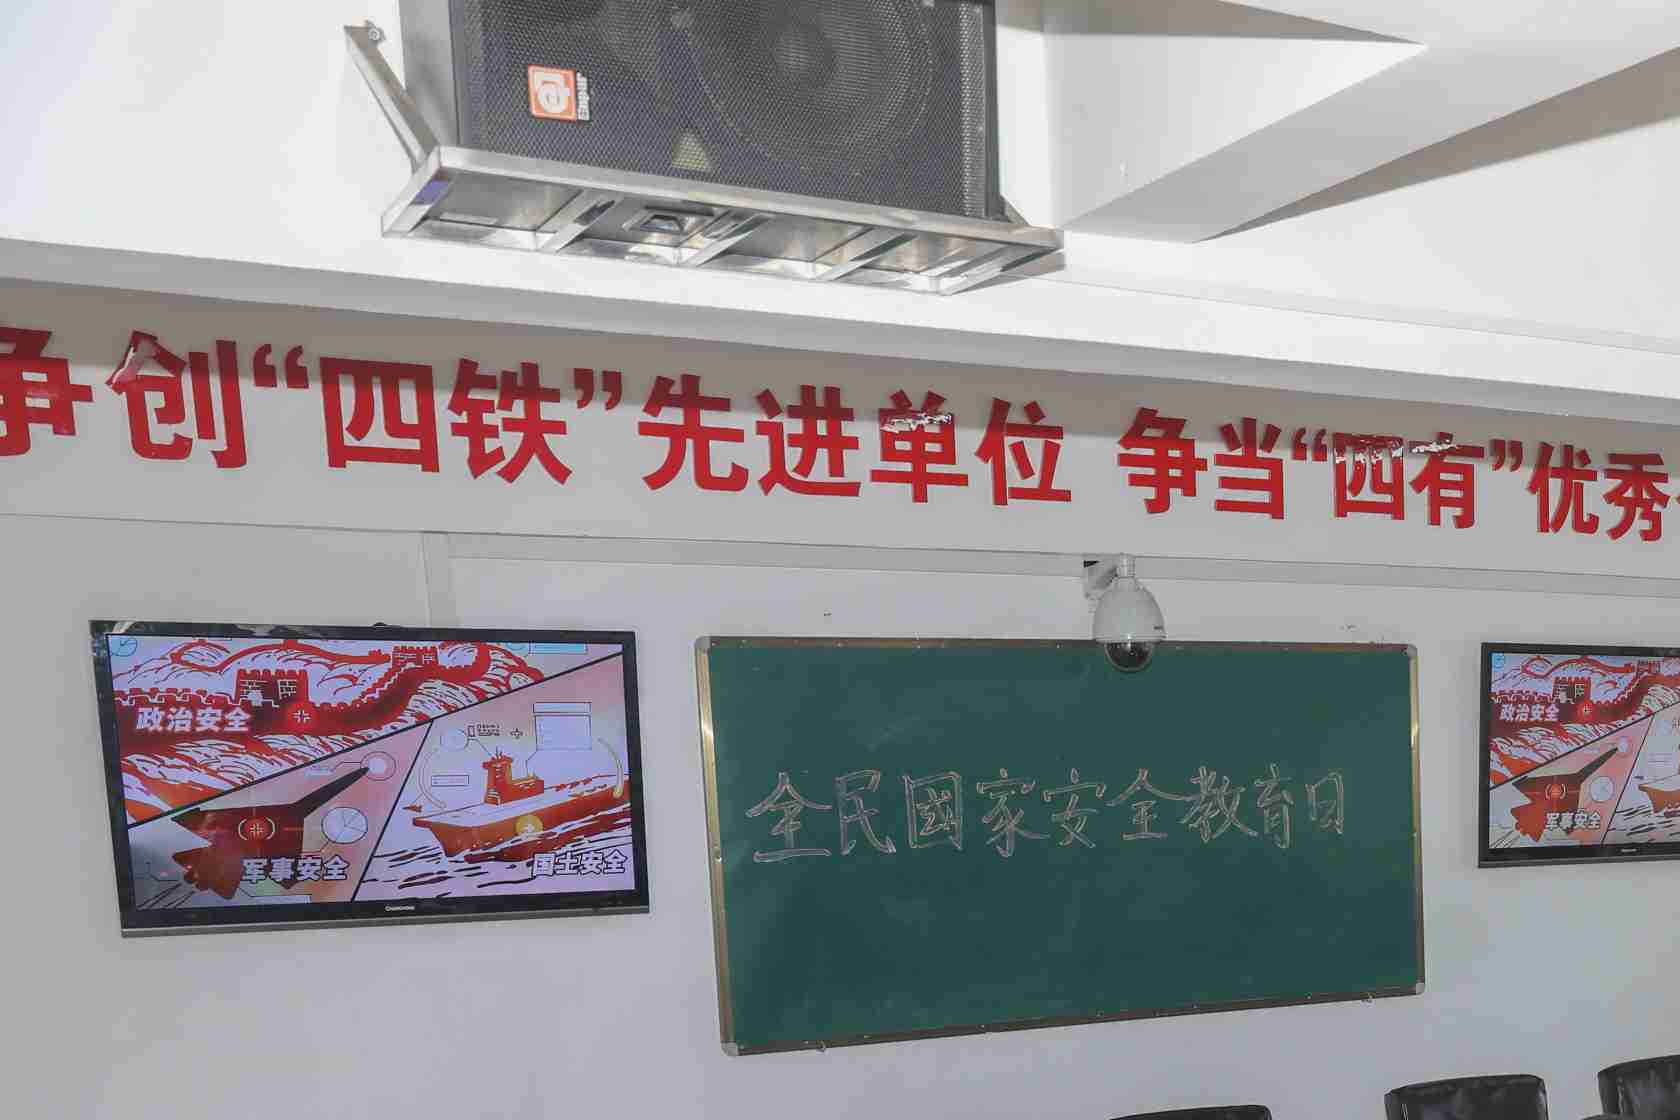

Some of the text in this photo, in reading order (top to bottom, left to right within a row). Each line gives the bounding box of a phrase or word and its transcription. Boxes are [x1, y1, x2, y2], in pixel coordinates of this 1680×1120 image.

[135, 705, 252, 733] 政治安全
[1499, 703, 1560, 721] 政治安全
[241, 855, 350, 883] 军事安全
[531, 849, 628, 876] 国土安全
